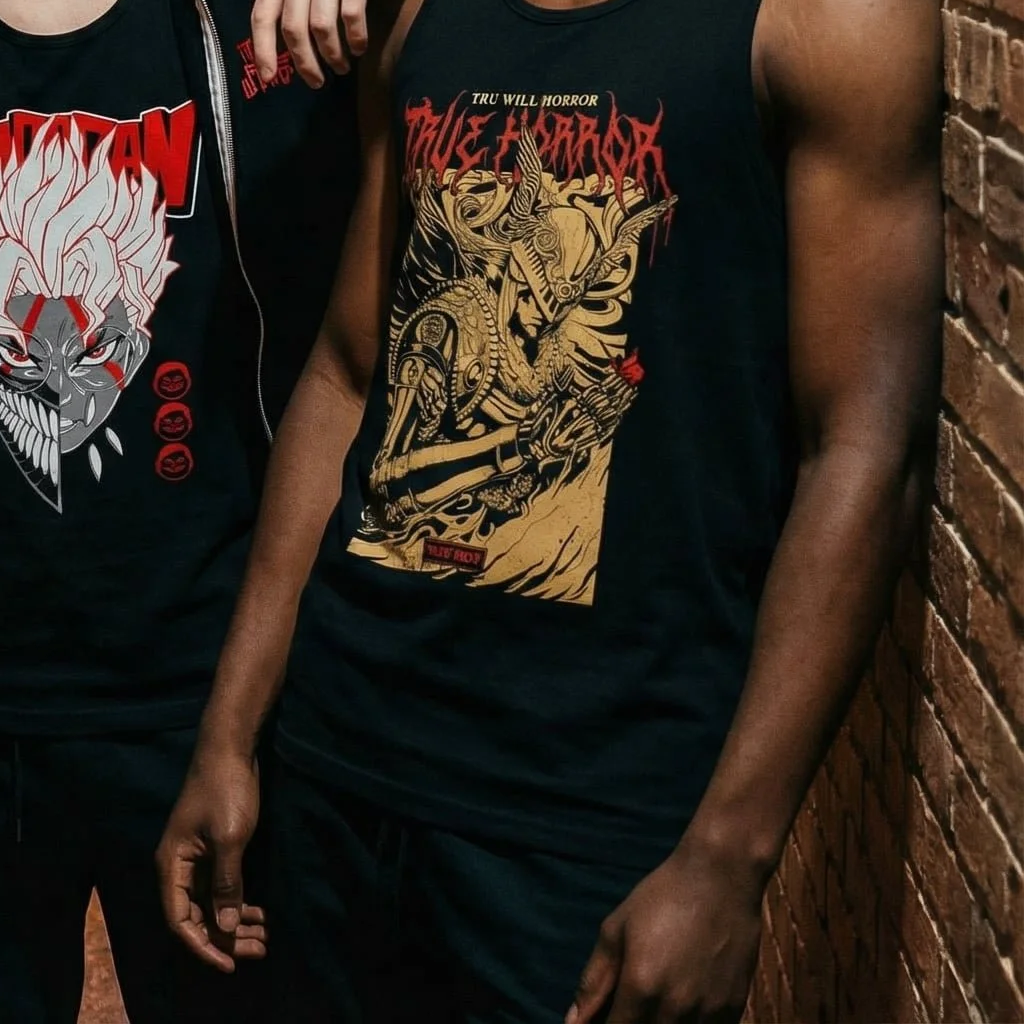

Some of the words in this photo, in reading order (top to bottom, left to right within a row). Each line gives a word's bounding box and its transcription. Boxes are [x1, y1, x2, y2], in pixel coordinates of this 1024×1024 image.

[471, 92, 500, 106] TRU
[503, 94, 538, 107] WILL
[540, 94, 599, 107] HORROR
[404, 91, 496, 194] TRUE
